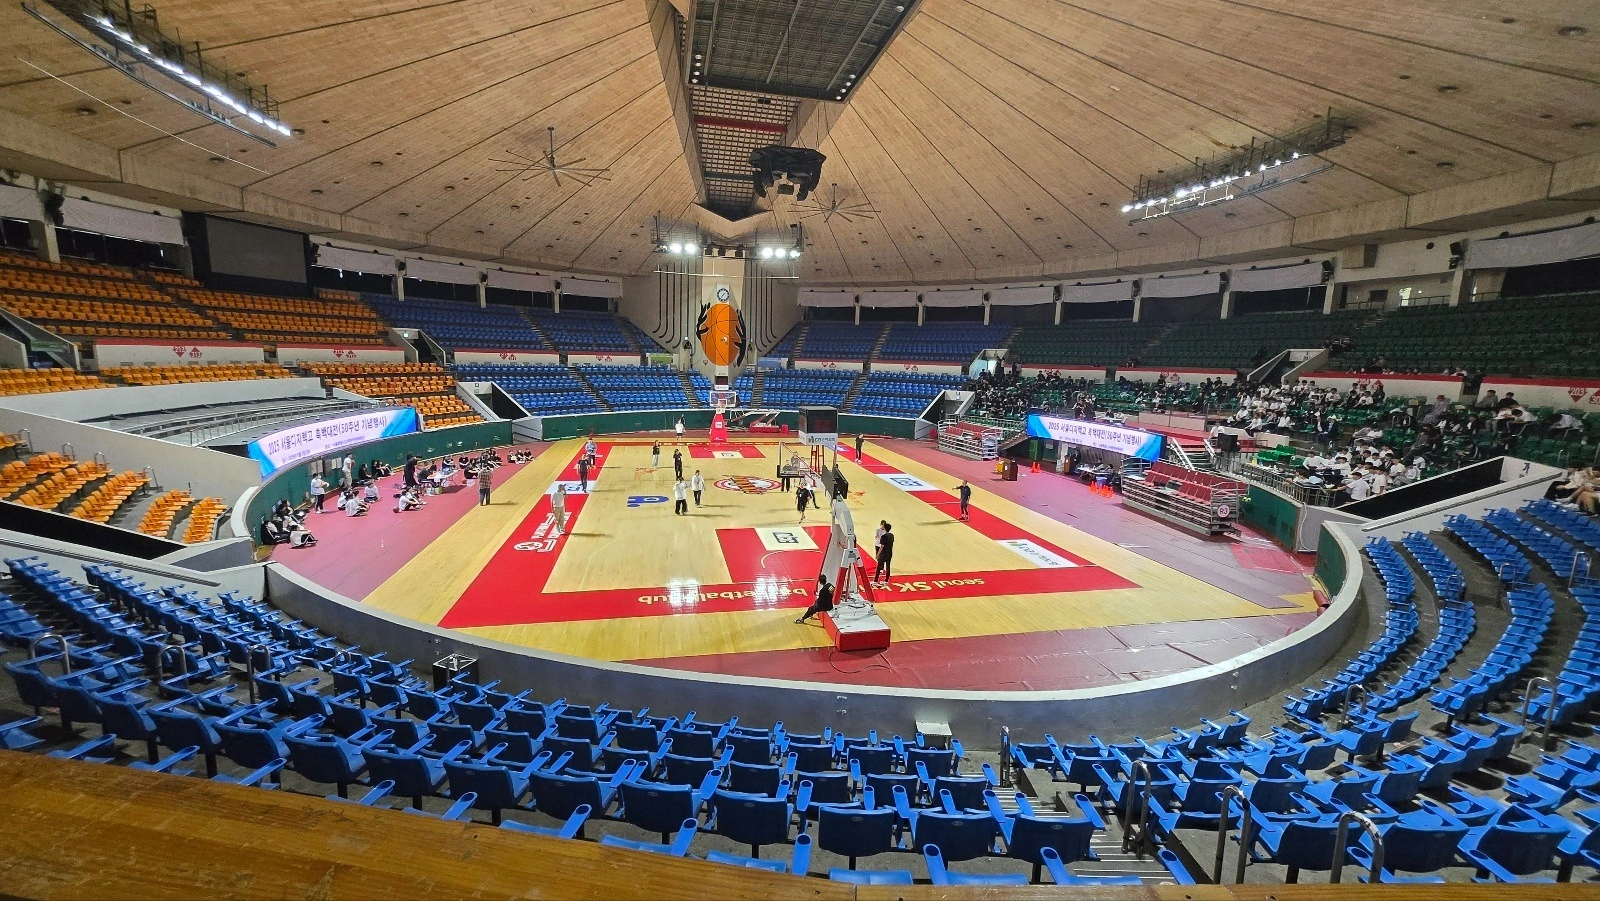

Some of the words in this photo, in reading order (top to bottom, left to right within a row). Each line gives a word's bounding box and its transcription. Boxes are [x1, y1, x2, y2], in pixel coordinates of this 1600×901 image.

[1570, 387, 1585, 397] 203
[268, 439, 280, 455] 2025
[890, 581, 932, 593] SK
[931, 578, 985, 589] seoul
